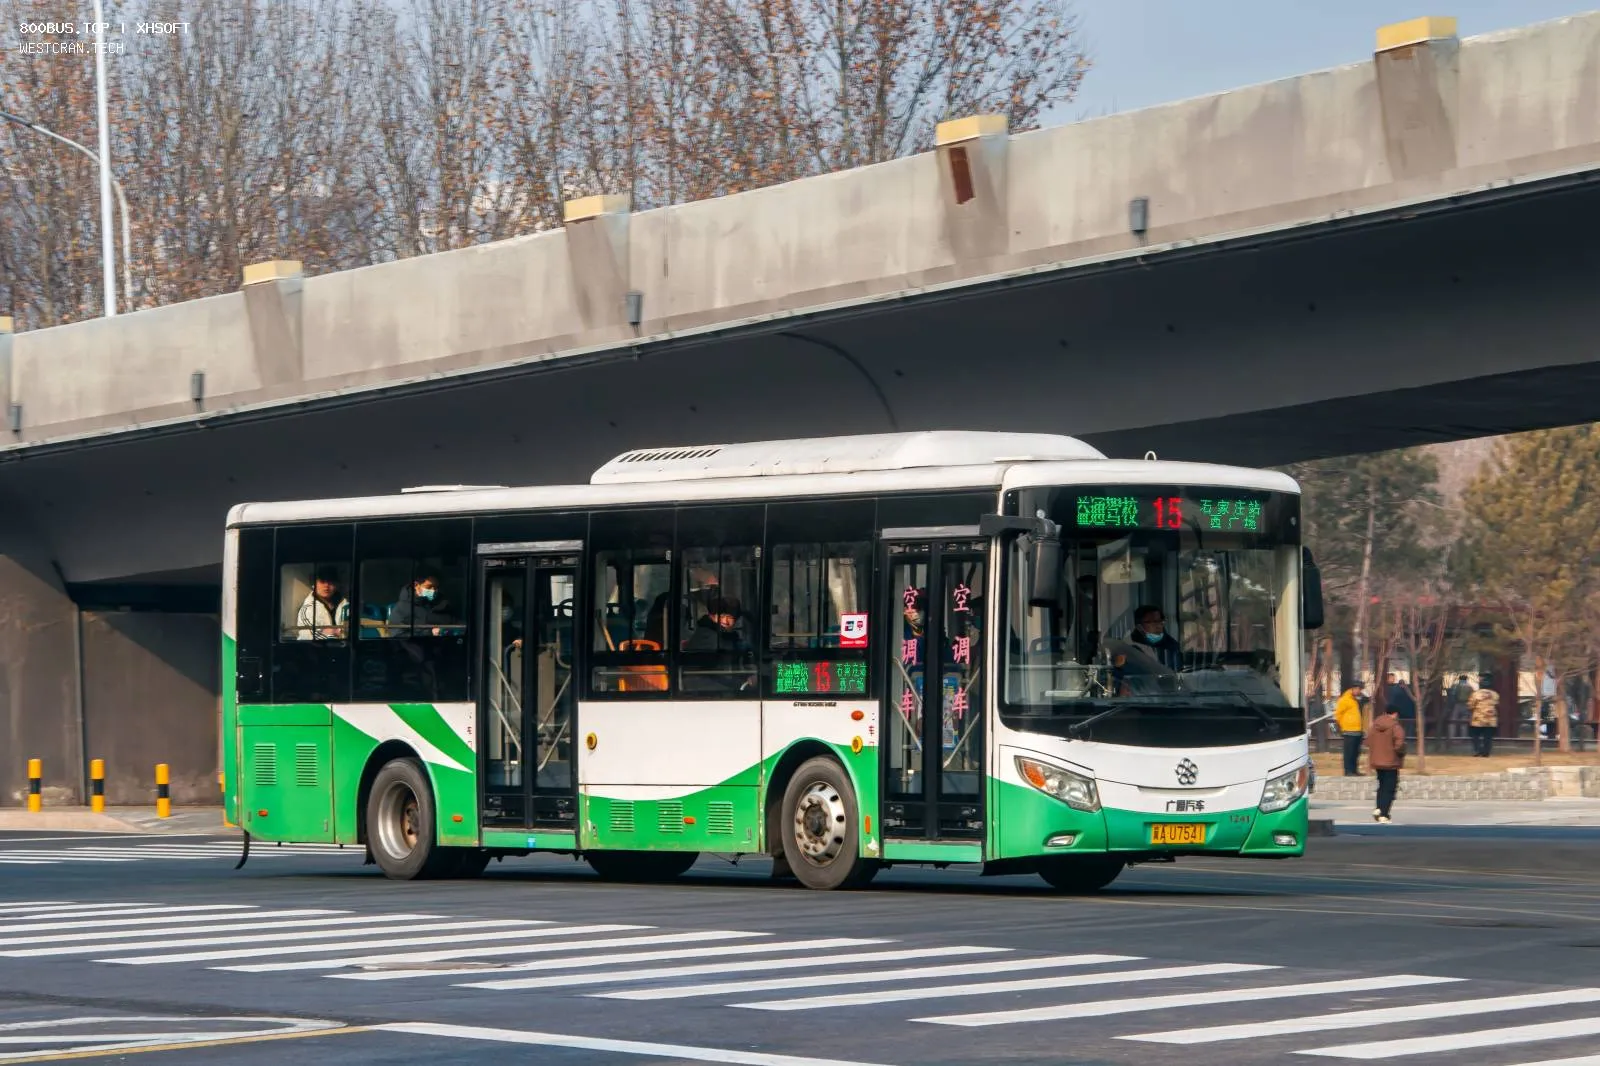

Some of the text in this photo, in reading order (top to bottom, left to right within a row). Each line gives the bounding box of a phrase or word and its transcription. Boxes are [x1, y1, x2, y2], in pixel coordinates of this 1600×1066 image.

[1077, 496, 1138, 526] 益通驾校
[1152, 497, 1184, 528] 15
[1200, 499, 1261, 516] 石家庄站
[1210, 514, 1256, 530] 西广场
[900, 585, 919, 720] 空调车
[951, 584, 971, 720] 空调车
[814, 661, 831, 692] 15
